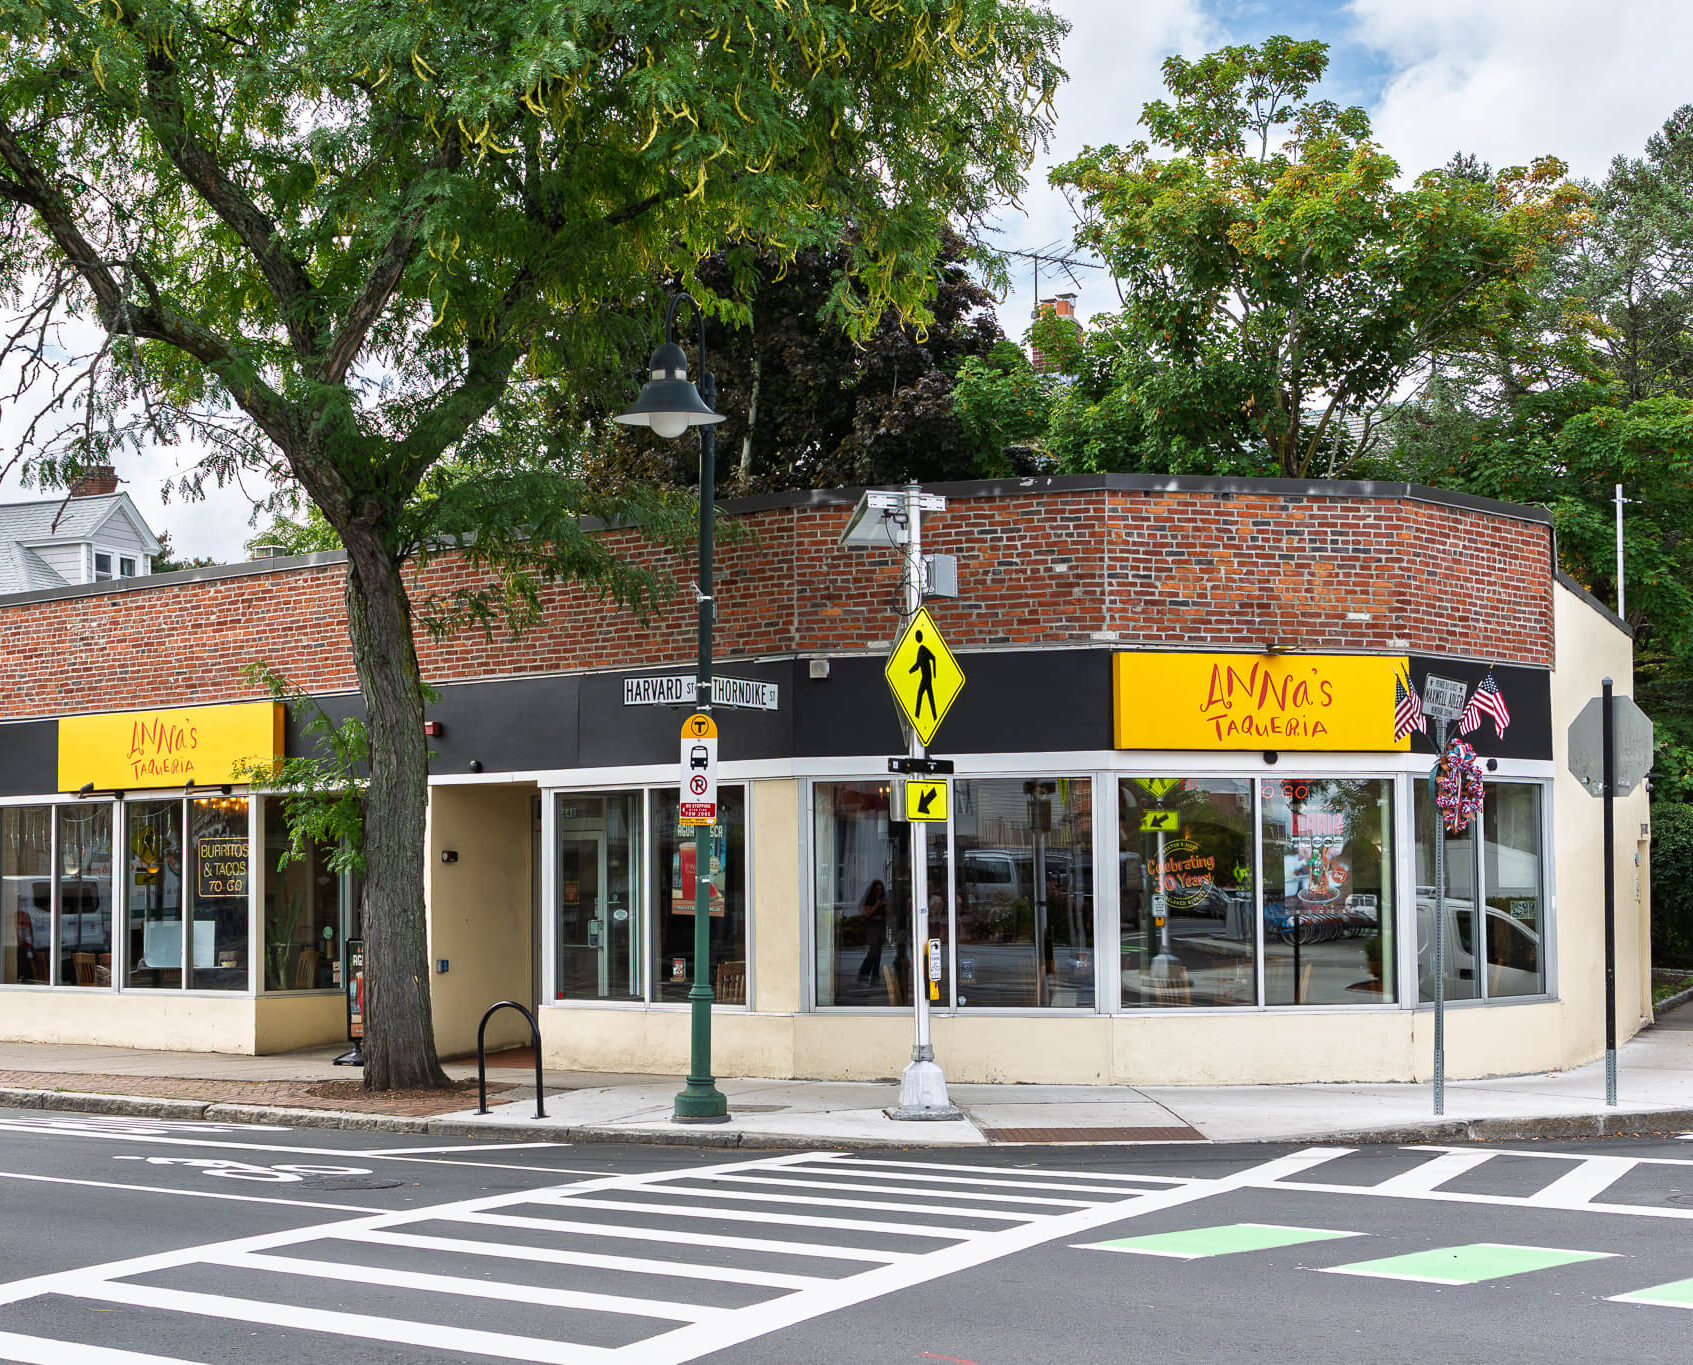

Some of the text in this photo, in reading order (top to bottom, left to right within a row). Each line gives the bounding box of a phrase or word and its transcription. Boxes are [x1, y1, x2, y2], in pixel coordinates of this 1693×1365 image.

[626, 678, 696, 703] HARVARD ST
[712, 678, 776, 706] THORNDIKE ST
[694, 721, 706, 733] T
[1281, 785, 1308, 799] GO
[201, 843, 249, 858] BURRITOS
[203, 861, 247, 877] & TACOS
[1147, 854, 1215, 875] Celebrating
[208, 879, 243, 892] TO GO
